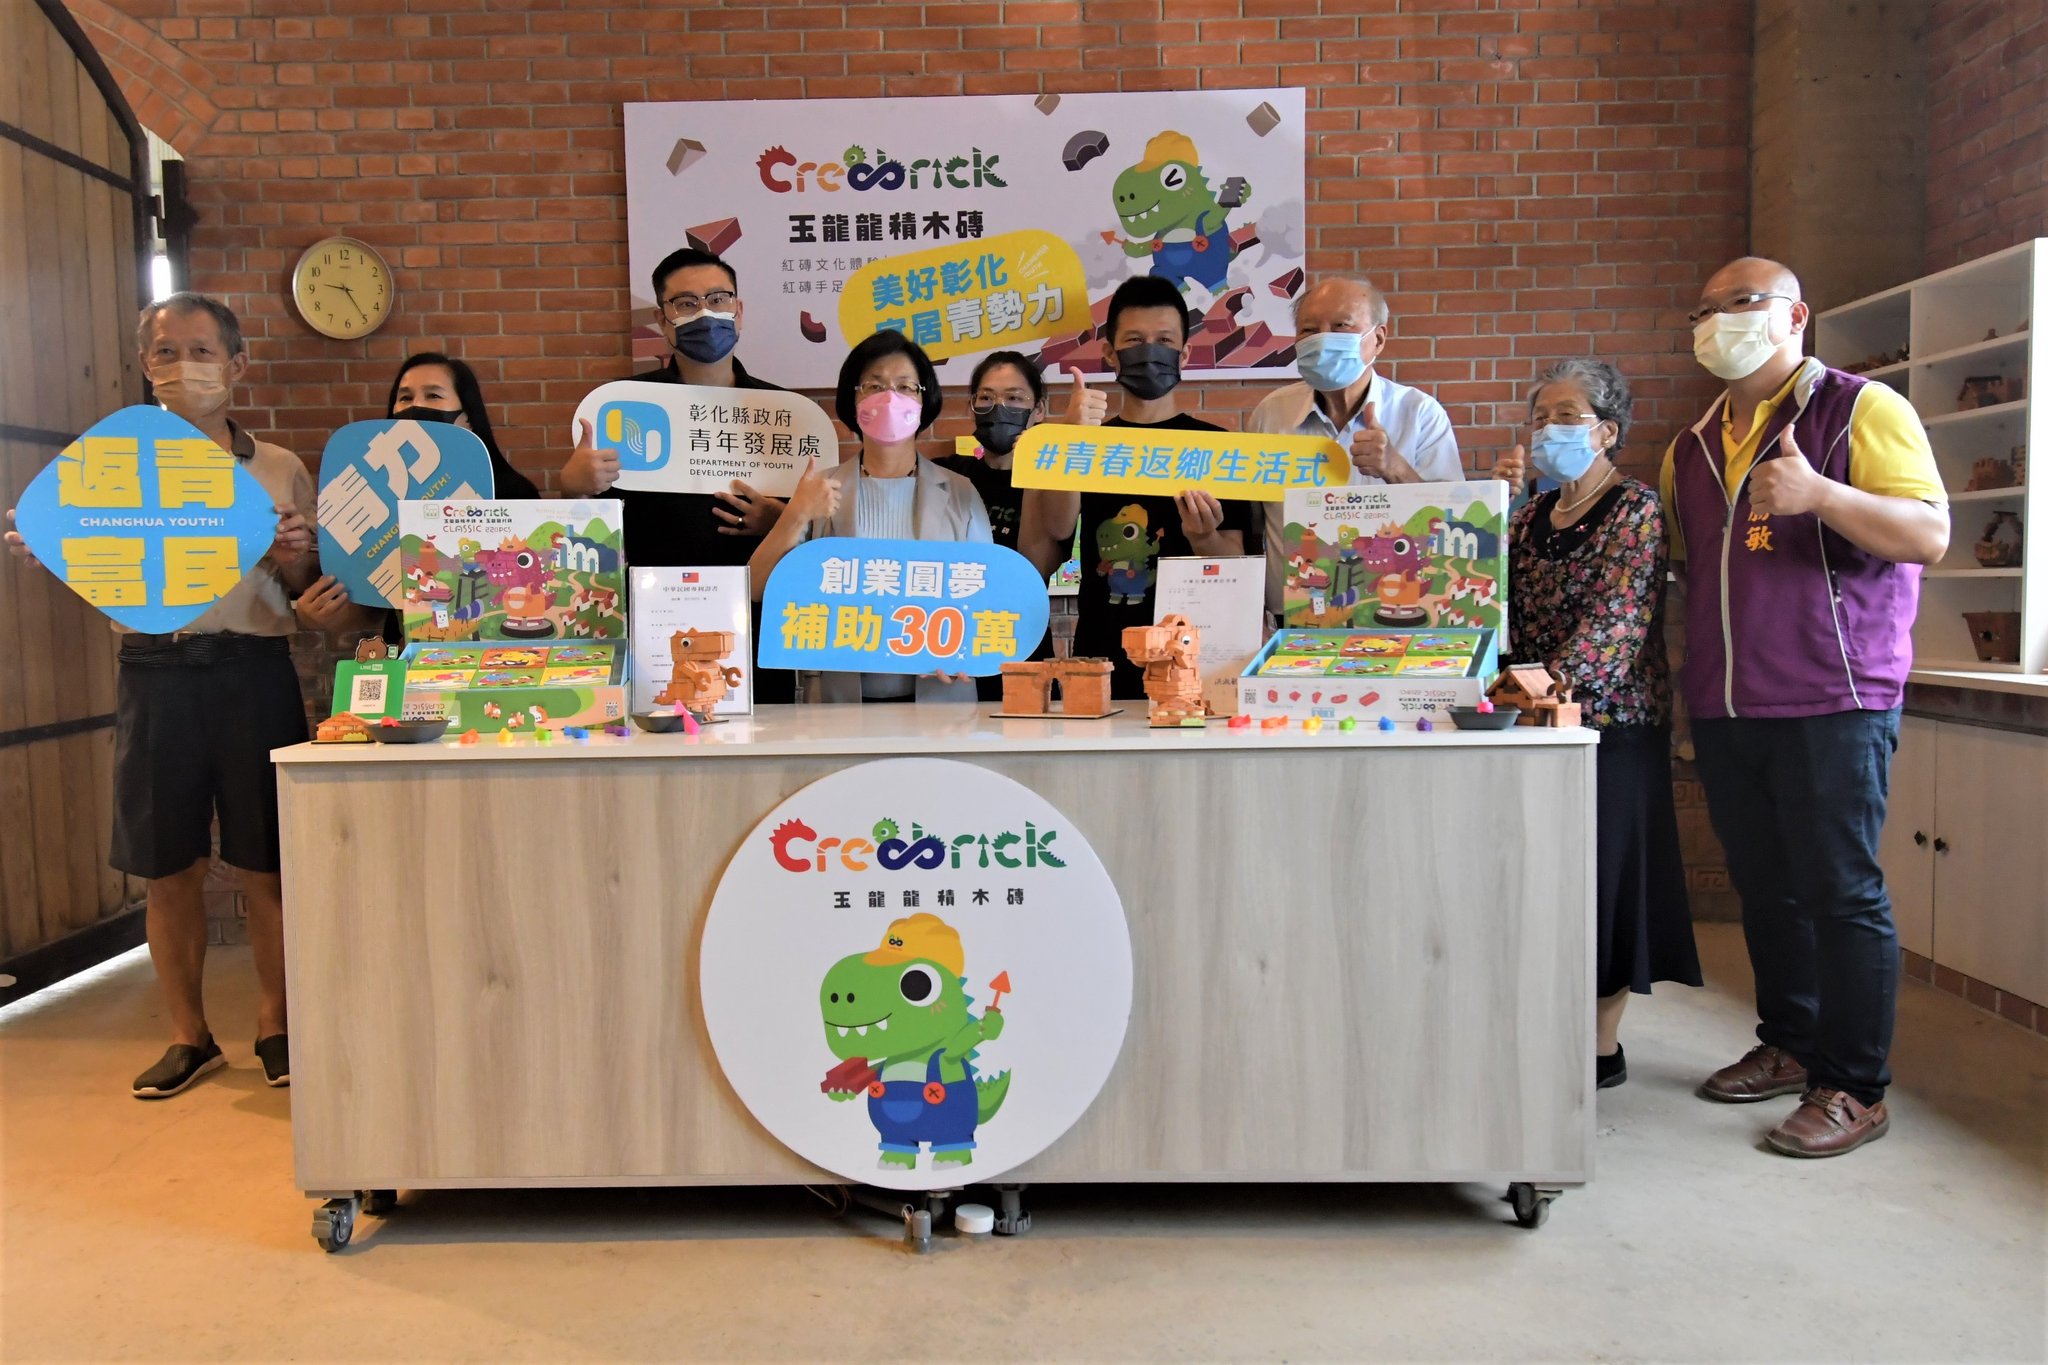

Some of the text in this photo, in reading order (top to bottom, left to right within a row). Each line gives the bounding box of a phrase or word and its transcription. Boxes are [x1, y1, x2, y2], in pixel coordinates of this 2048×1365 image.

[789, 210, 984, 243] 玉龍龍積木磚
[324, 254, 331, 264] 11
[340, 249, 350, 260] 12
[311, 267, 320, 277] 10
[371, 266, 378, 277] 2
[871, 253, 1008, 311] 美好彰化
[308, 284, 315, 294] 9
[377, 284, 383, 295] 3
[314, 301, 320, 311] 8
[373, 302, 379, 311] 4
[328, 313, 334, 323] 7
[344, 319, 351, 329] 6
[689, 403, 793, 427] 彰化縣政府
[688, 428, 821, 458] 青年發展處
[689, 458, 747, 468] DEPARTMENT
[763, 462, 794, 470] YOUTH
[1033, 441, 1330, 488] #青春返鄉生活式
[689, 469, 753, 478] DEVELOPMENT
[421, 472, 451, 501] OUTH!
[1323, 511, 1360, 520] CLASSIC
[79, 517, 225, 527] CHANGHUA YOUTH!
[442, 525, 482, 533] CLASSIC
[819, 556, 987, 599] 創業圓夢
[780, 601, 1021, 658] 補助30萬
[833, 888, 1024, 909] 玉龍龍積木磚
